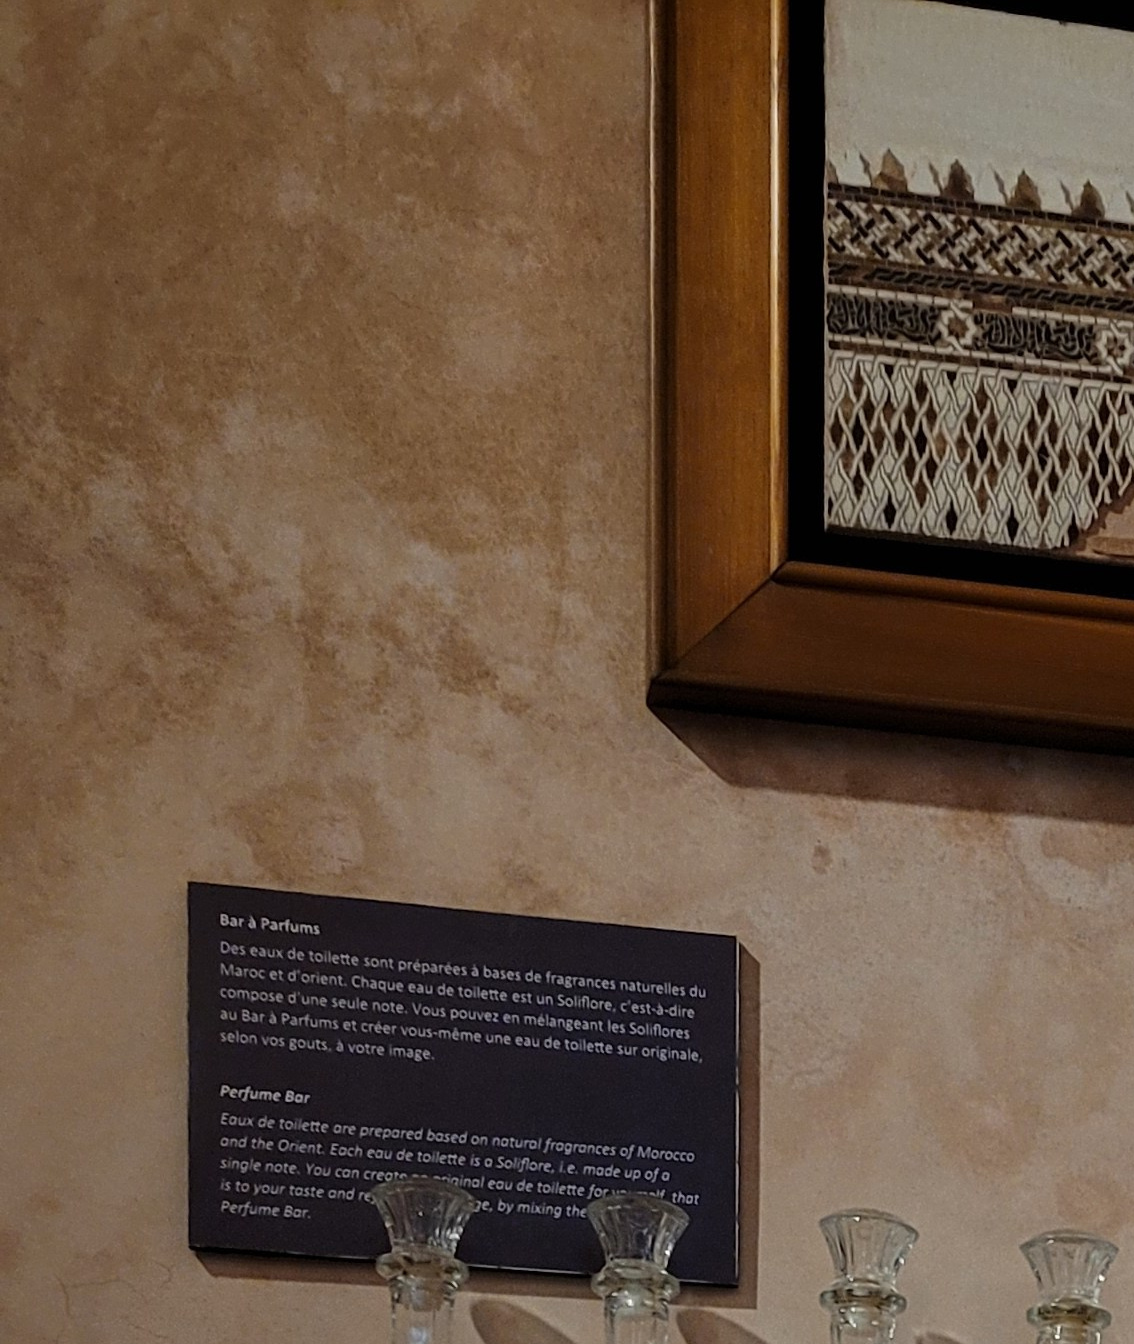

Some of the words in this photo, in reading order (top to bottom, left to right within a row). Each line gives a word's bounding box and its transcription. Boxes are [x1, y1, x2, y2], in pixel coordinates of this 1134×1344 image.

[219, 913, 244, 927] Bar
[247, 914, 256, 929] à
[260, 917, 320, 935] Parfums
[219, 940, 246, 955] Des
[249, 946, 283, 959] eaux
[286, 946, 304, 961] de
[308, 950, 359, 966] toilette
[363, 956, 394, 969] sont
[470, 963, 479, 977] à
[482, 964, 521, 981] bases
[524, 969, 542, 983] de
[545, 970, 616, 990] fragrances
[619, 980, 685, 996] naturelles
[688, 984, 706, 998] du
[219, 962, 265, 979] Maroc
[268, 969, 284, 981] et
[351, 974, 404, 993] Chaque
[407, 982, 433, 994] eau
[436, 982, 454, 996] de
[457, 985, 507, 1001] toilette
[511, 992, 532, 1004] est
[536, 994, 553, 1005] un
[219, 1009, 237, 1020] au
[241, 1008, 265, 1023] Bar
[268, 1010, 277, 1024] à
[281, 1012, 339, 1029] Parfums
[342, 1019, 357, 1032] et
[399, 1025, 481, 1042] vous-même
[485, 1033, 511, 1045] une
[514, 1035, 540, 1047] eau
[543, 1035, 561, 1049] de
[564, 1038, 613, 1054] toilette
[331, 996, 368, 1010] seule
[371, 1001, 407, 1014] note.
[411, 1001, 446, 1017] Vous
[449, 1008, 499, 1022] pouvez
[502, 1012, 520, 1024] en
[607, 1018, 625, 1034] les
[628, 1021, 690, 1039] Soliflores
[219, 1029, 257, 1044] selon
[260, 1035, 285, 1047] vos
[335, 1038, 344, 1052] à
[347, 1043, 384, 1056] votre
[388, 1043, 434, 1061] image.
[219, 1084, 281, 1102] Perfume
[284, 1089, 310, 1103] Bar
[220, 1112, 254, 1126] Eaux
[257, 1114, 275, 1129] de
[278, 1118, 329, 1133] toilette
[332, 1123, 356, 1135] are
[359, 1126, 423, 1140] prepared
[425, 1128, 467, 1143] based
[470, 1134, 488, 1145] on
[491, 1136, 542, 1149] natural
[542, 1137, 616, 1156] fragrances
[619, 1143, 635, 1160] of
[636, 1145, 695, 1162] Morocco
[219, 1135, 247, 1148] and
[251, 1136, 274, 1150] the
[277, 1138, 324, 1154] Orient.
[329, 1142, 362, 1157] Each
[366, 1148, 392, 1159] eau
[395, 1148, 413, 1161] de
[416, 1150, 466, 1166] toilette
[469, 1153, 480, 1166] is
[484, 1157, 493, 1167] a
[582, 1163, 620, 1177] made
[623, 1169, 641, 1181] up
[643, 1167, 659, 1183] of
[660, 1171, 670, 1181] a
[219, 1156, 261, 1173] single
[264, 1162, 300, 1174] note.
[305, 1162, 331, 1176] You
[334, 1167, 359, 1178] can
[487, 1179, 513, 1190] eau
[515, 1178, 533, 1192] de
[536, 1181, 584, 1196] toilette
[586, 1183, 609, 1201] for
[671, 1190, 700, 1205] that
[219, 1178, 231, 1191] is
[234, 1180, 250, 1192] to
[252, 1183, 285, 1195] your
[288, 1184, 324, 1198] taste
[327, 1187, 355, 1200] and
[497, 1198, 514, 1214] by
[516, 1201, 562, 1218] mixing
[565, 1204, 585, 1218] the
[220, 1199, 280, 1217] Perfume
[283, 1204, 311, 1219] Bar.
